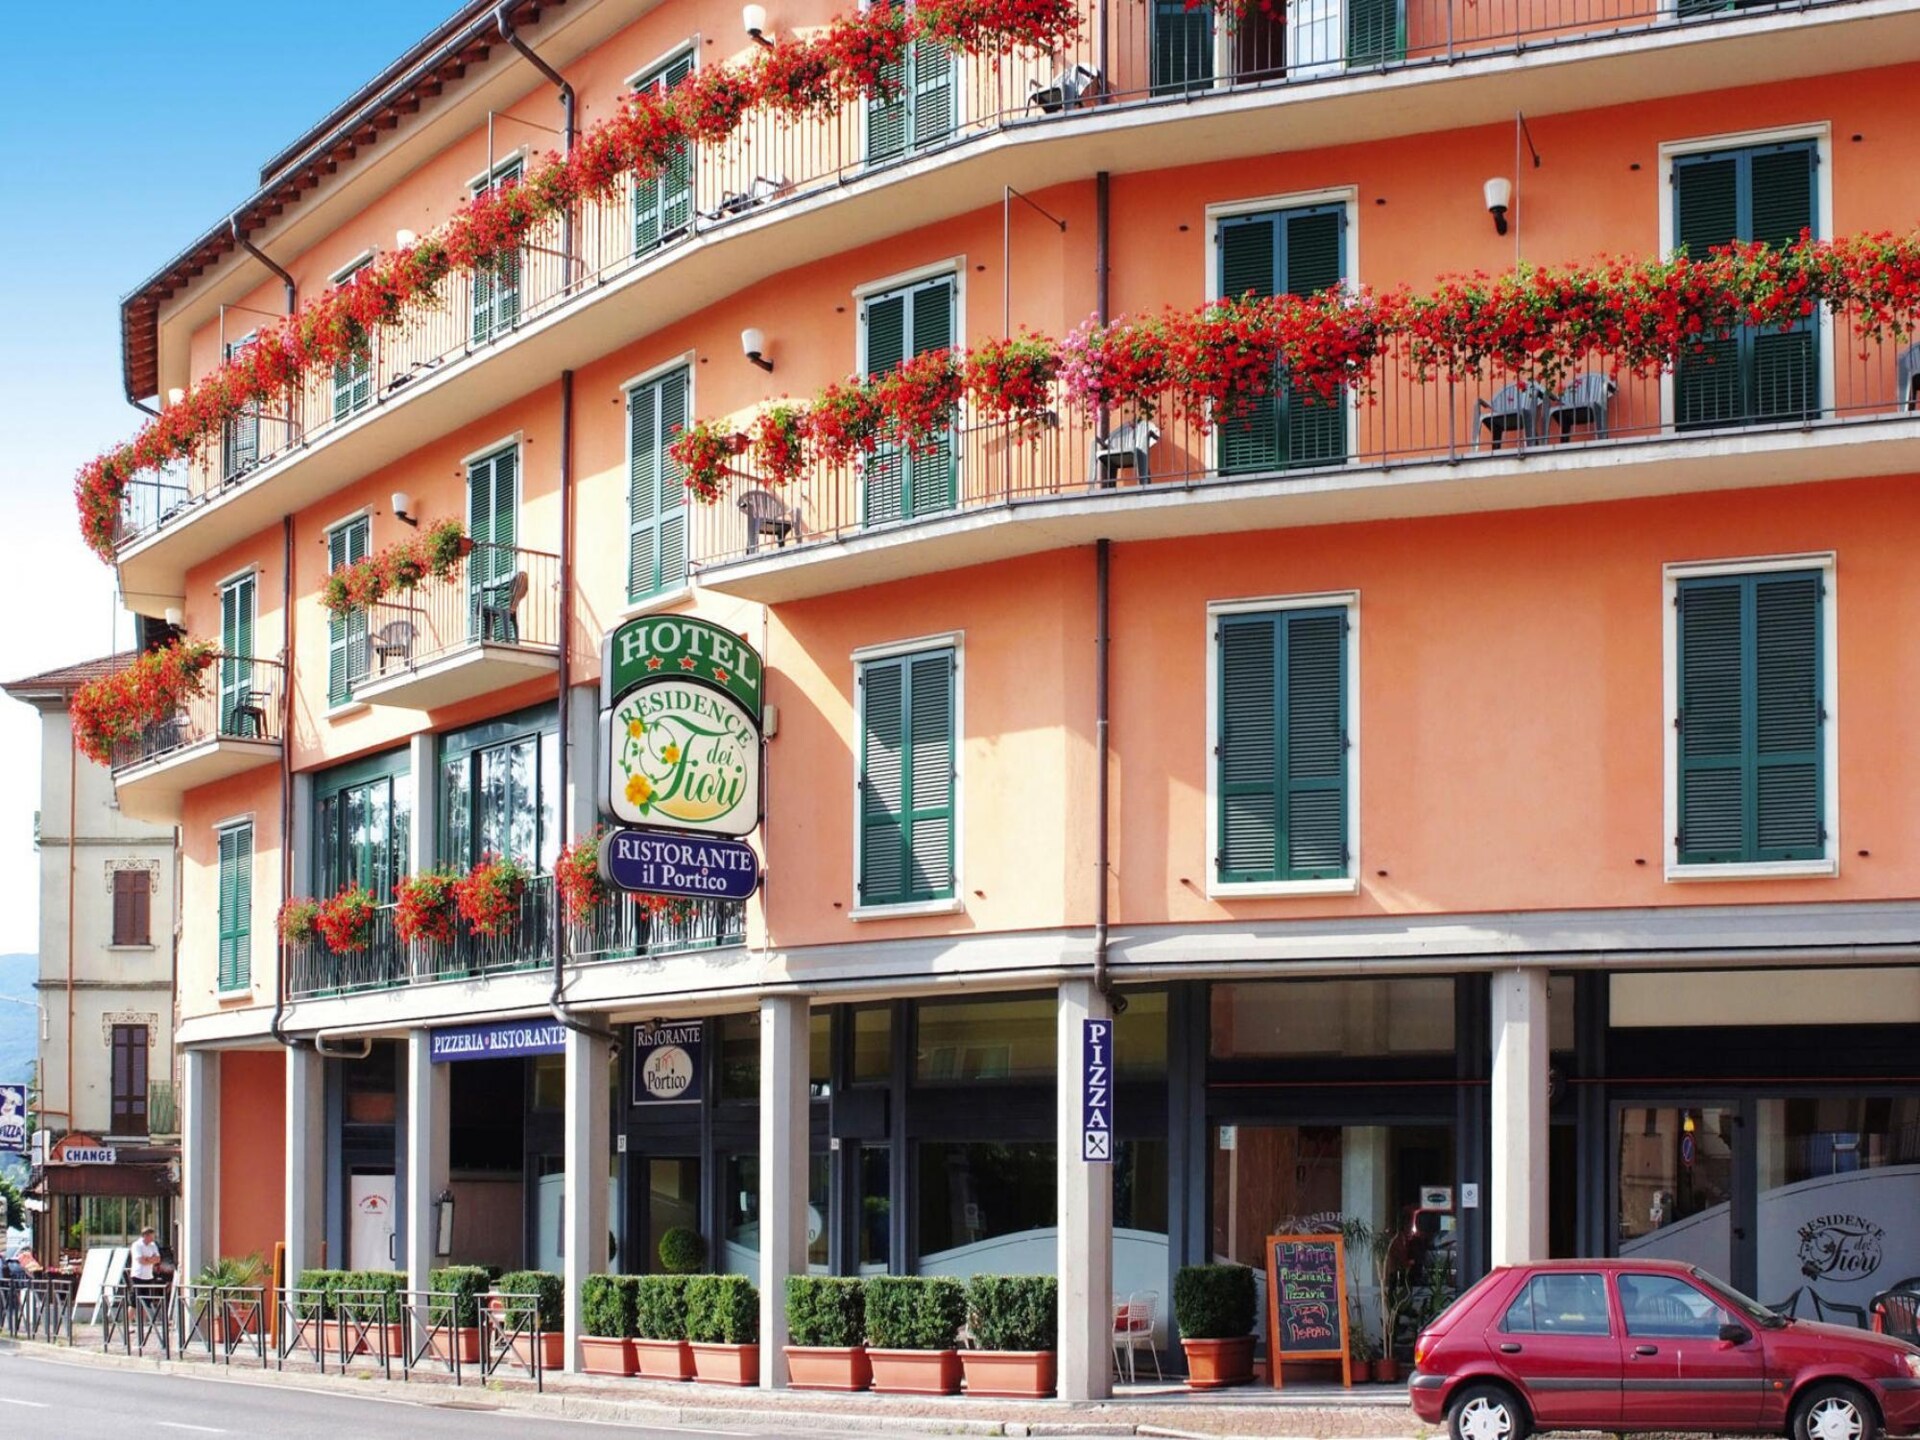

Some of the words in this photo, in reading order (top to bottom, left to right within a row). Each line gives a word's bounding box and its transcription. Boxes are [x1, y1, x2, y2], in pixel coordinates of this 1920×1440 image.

[620, 621, 757, 690] HOTEL
[618, 690, 753, 750] RESIDENCE
[656, 714, 743, 807] Fiori
[706, 737, 734, 767] dei
[617, 838, 752, 872] RISTORANTE
[642, 863, 655, 885] il
[661, 864, 728, 891] Portico
[434, 1033, 483, 1053] PIZZERIA
[490, 1025, 566, 1049] RISTORANTE
[637, 1027, 701, 1046] RISTORANTE
[647, 1069, 687, 1090] Portico
[1086, 1023, 1108, 1128] PIZZA
[66, 1150, 113, 1162] CHANGE
[1797, 1214, 1886, 1242] RESIDENCE
